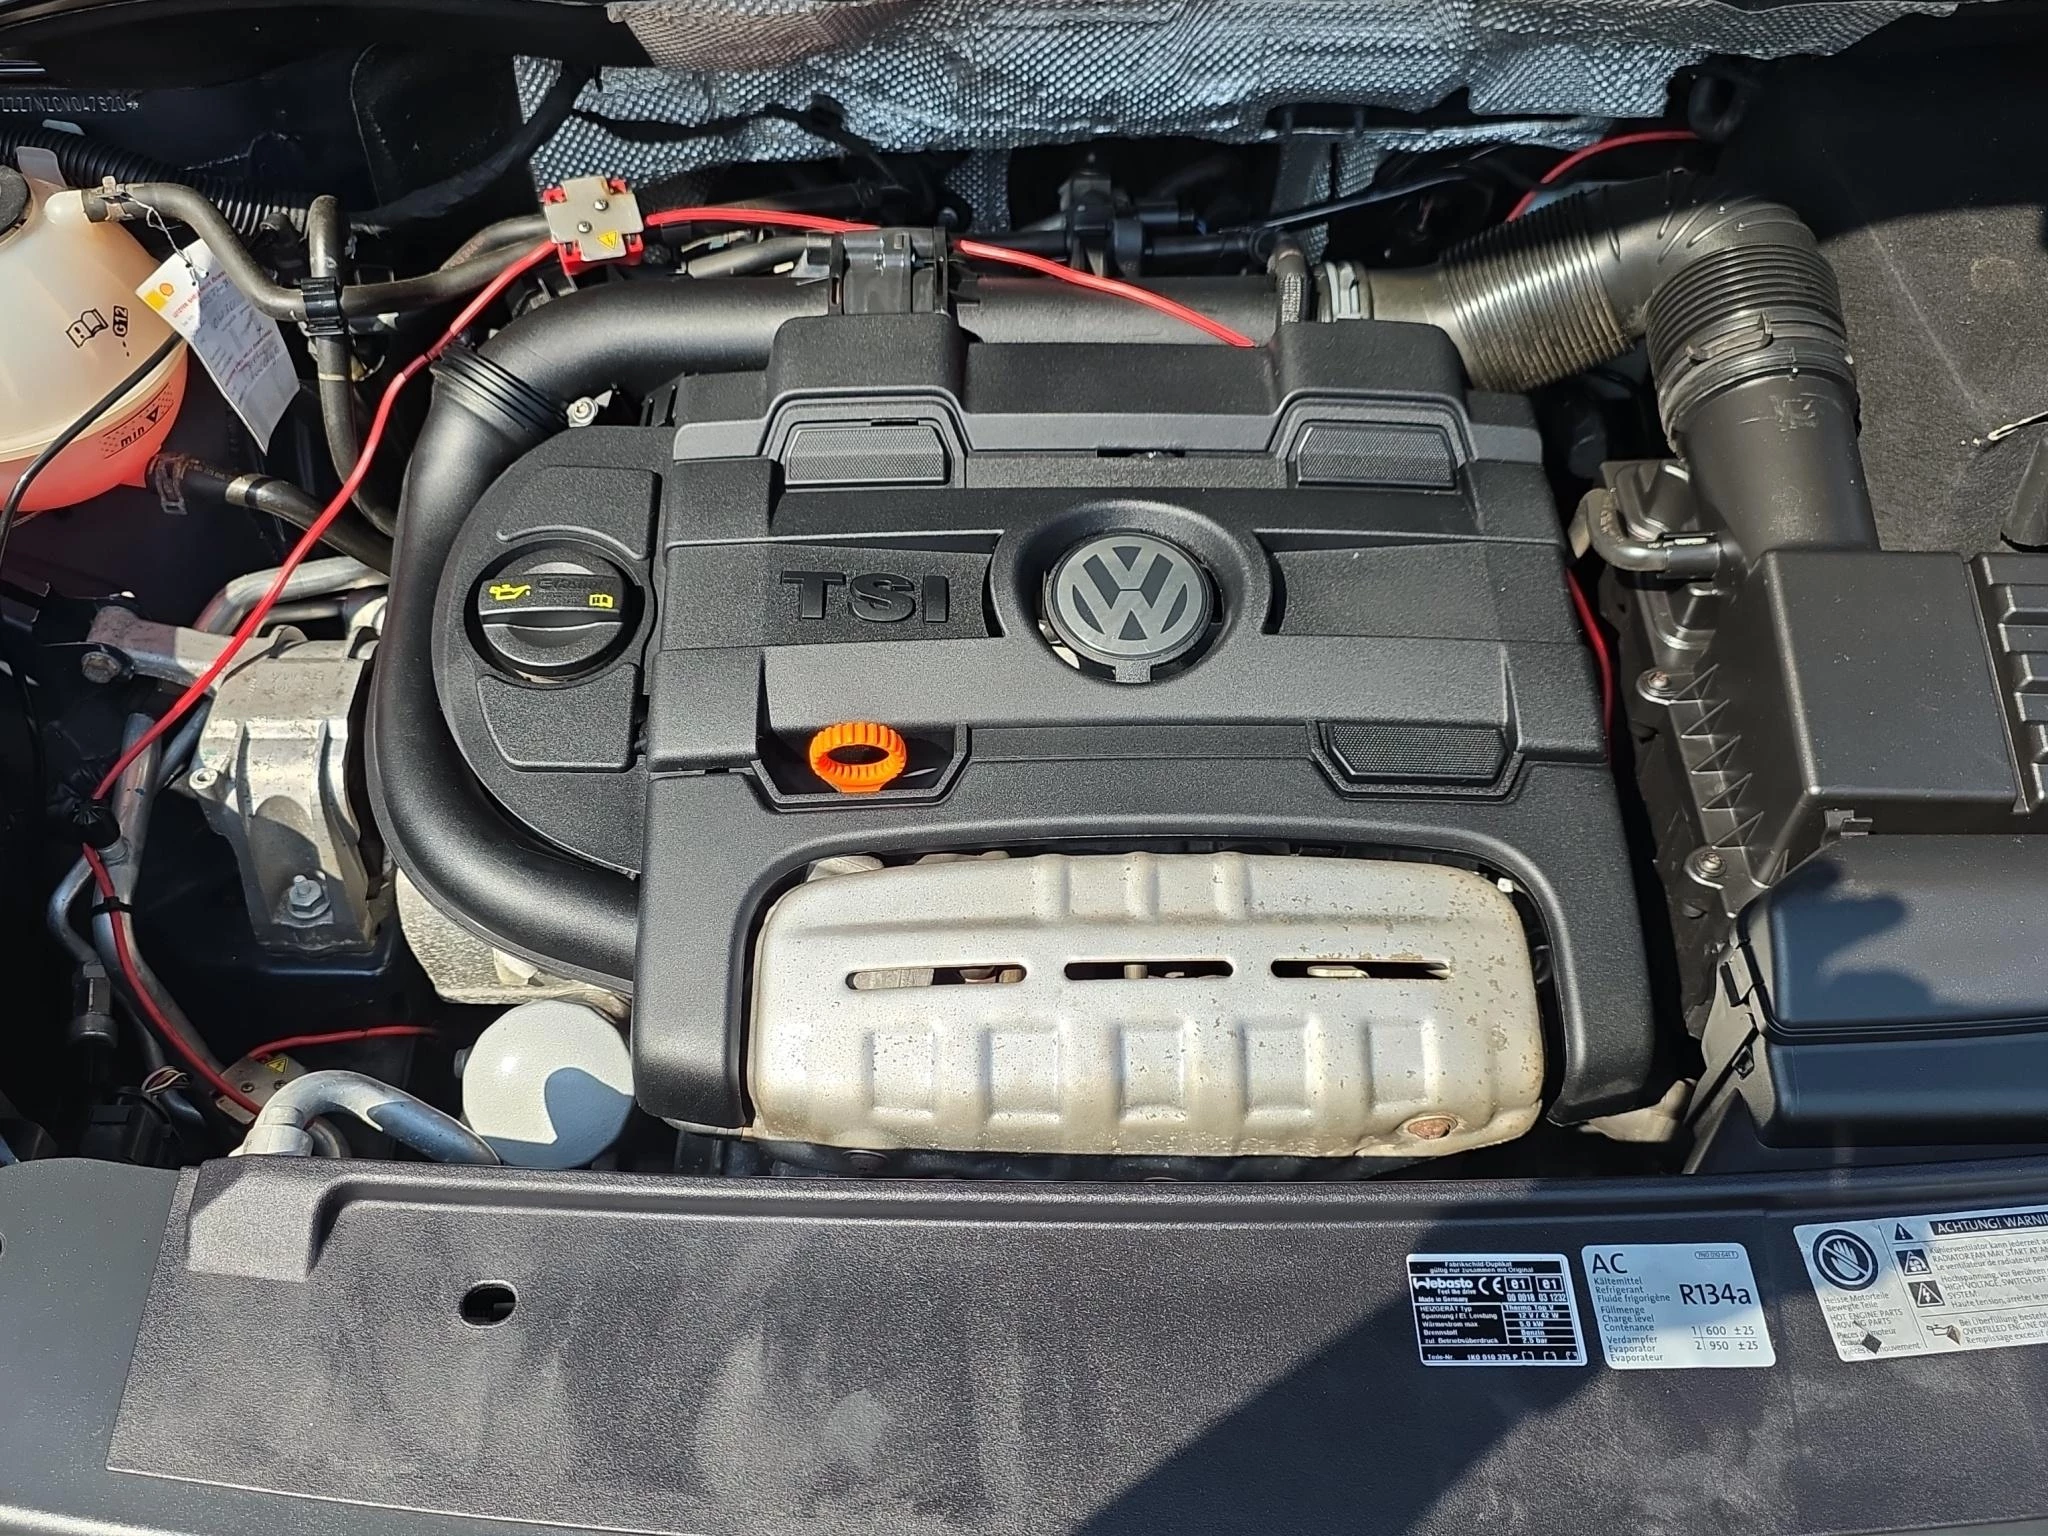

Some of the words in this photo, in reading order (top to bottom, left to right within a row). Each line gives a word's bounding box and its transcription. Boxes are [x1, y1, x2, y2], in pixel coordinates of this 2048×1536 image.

[115, 307, 128, 335] G12
[120, 426, 145, 448] min
[780, 569, 951, 624] TSI
[1938, 1218, 2001, 1234] ACHTUNG!
[1932, 1253, 1969, 1262] RADIATOR
[1971, 1252, 1986, 1260] FAN
[1988, 1249, 2005, 1257] MAY
[2006, 1248, 2027, 1256] START
[1592, 1253, 1627, 1274] AC
[1945, 1261, 1986, 1270] ventilateur
[1998, 1257, 2031, 1265] radiateur
[1413, 1277, 1473, 1290] Webasto
[1593, 1277, 1643, 1285] Kältemittel
[1944, 1282, 1966, 1291] HIGH
[2002, 1277, 2032, 1286] SWITCH
[1594, 1286, 1643, 1294] Refrigerant
[1679, 1284, 1752, 1304] R134a
[1597, 1294, 1623, 1302] Fluide
[1624, 1294, 1670, 1304] frigorigène
[1849, 1292, 1890, 1301] Motorteile
[1951, 1300, 1976, 1308] Haute
[1600, 1306, 1645, 1315] Füllmenge
[1849, 1311, 1879, 1320] ENGINE
[1880, 1308, 1903, 1317] PARTS
[1602, 1315, 1633, 1324] Charge
[1634, 1314, 1654, 1322] level
[1868, 1318, 1892, 1326] PARTS
[1972, 1315, 2018, 1325] Überfüllung
[1706, 1326, 1726, 1335] 600
[1735, 1326, 1754, 1335] ±25
[1962, 1324, 2006, 1335] OVERFILLED
[2008, 1321, 2038, 1331] ENGINE
[1606, 1335, 1657, 1346] Verdampfer
[1966, 1334, 2013, 1344] Remplissage
[2014, 1331, 2044, 1339] excessif
[1608, 1345, 1656, 1354] Evaporator
[1695, 1341, 1702, 1350] 2
[1709, 1341, 1729, 1350] 950
[1739, 1341, 1758, 1350] ±25
[1610, 1354, 1664, 1363] Evaporateur
